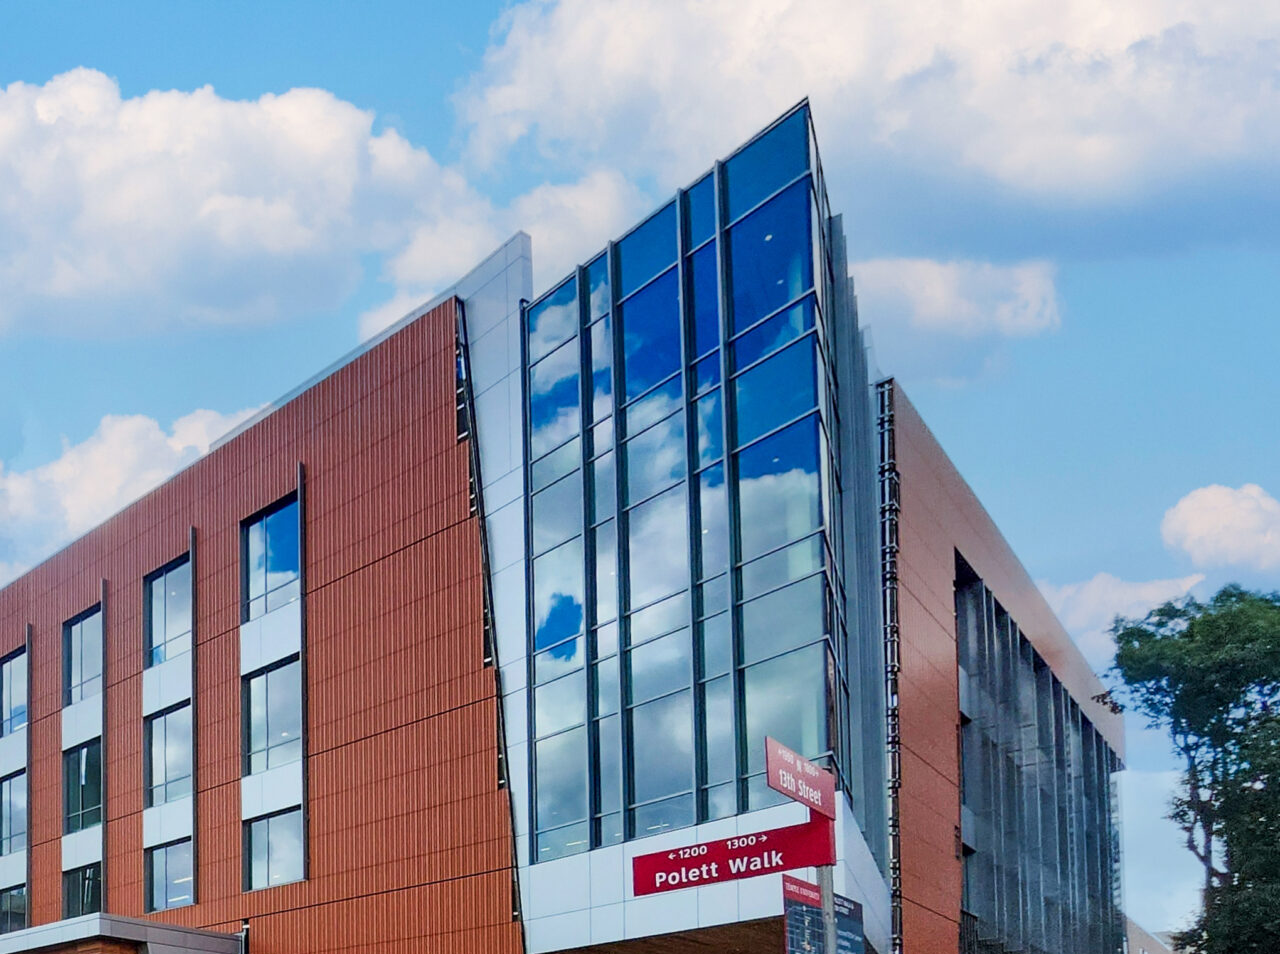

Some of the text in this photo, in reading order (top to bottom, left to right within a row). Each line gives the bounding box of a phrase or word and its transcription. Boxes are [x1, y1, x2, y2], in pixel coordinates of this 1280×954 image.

[779, 769, 822, 806] 13th Street
[678, 835, 757, 859] 1200 1300
[655, 850, 784, 888] Polett Walk
